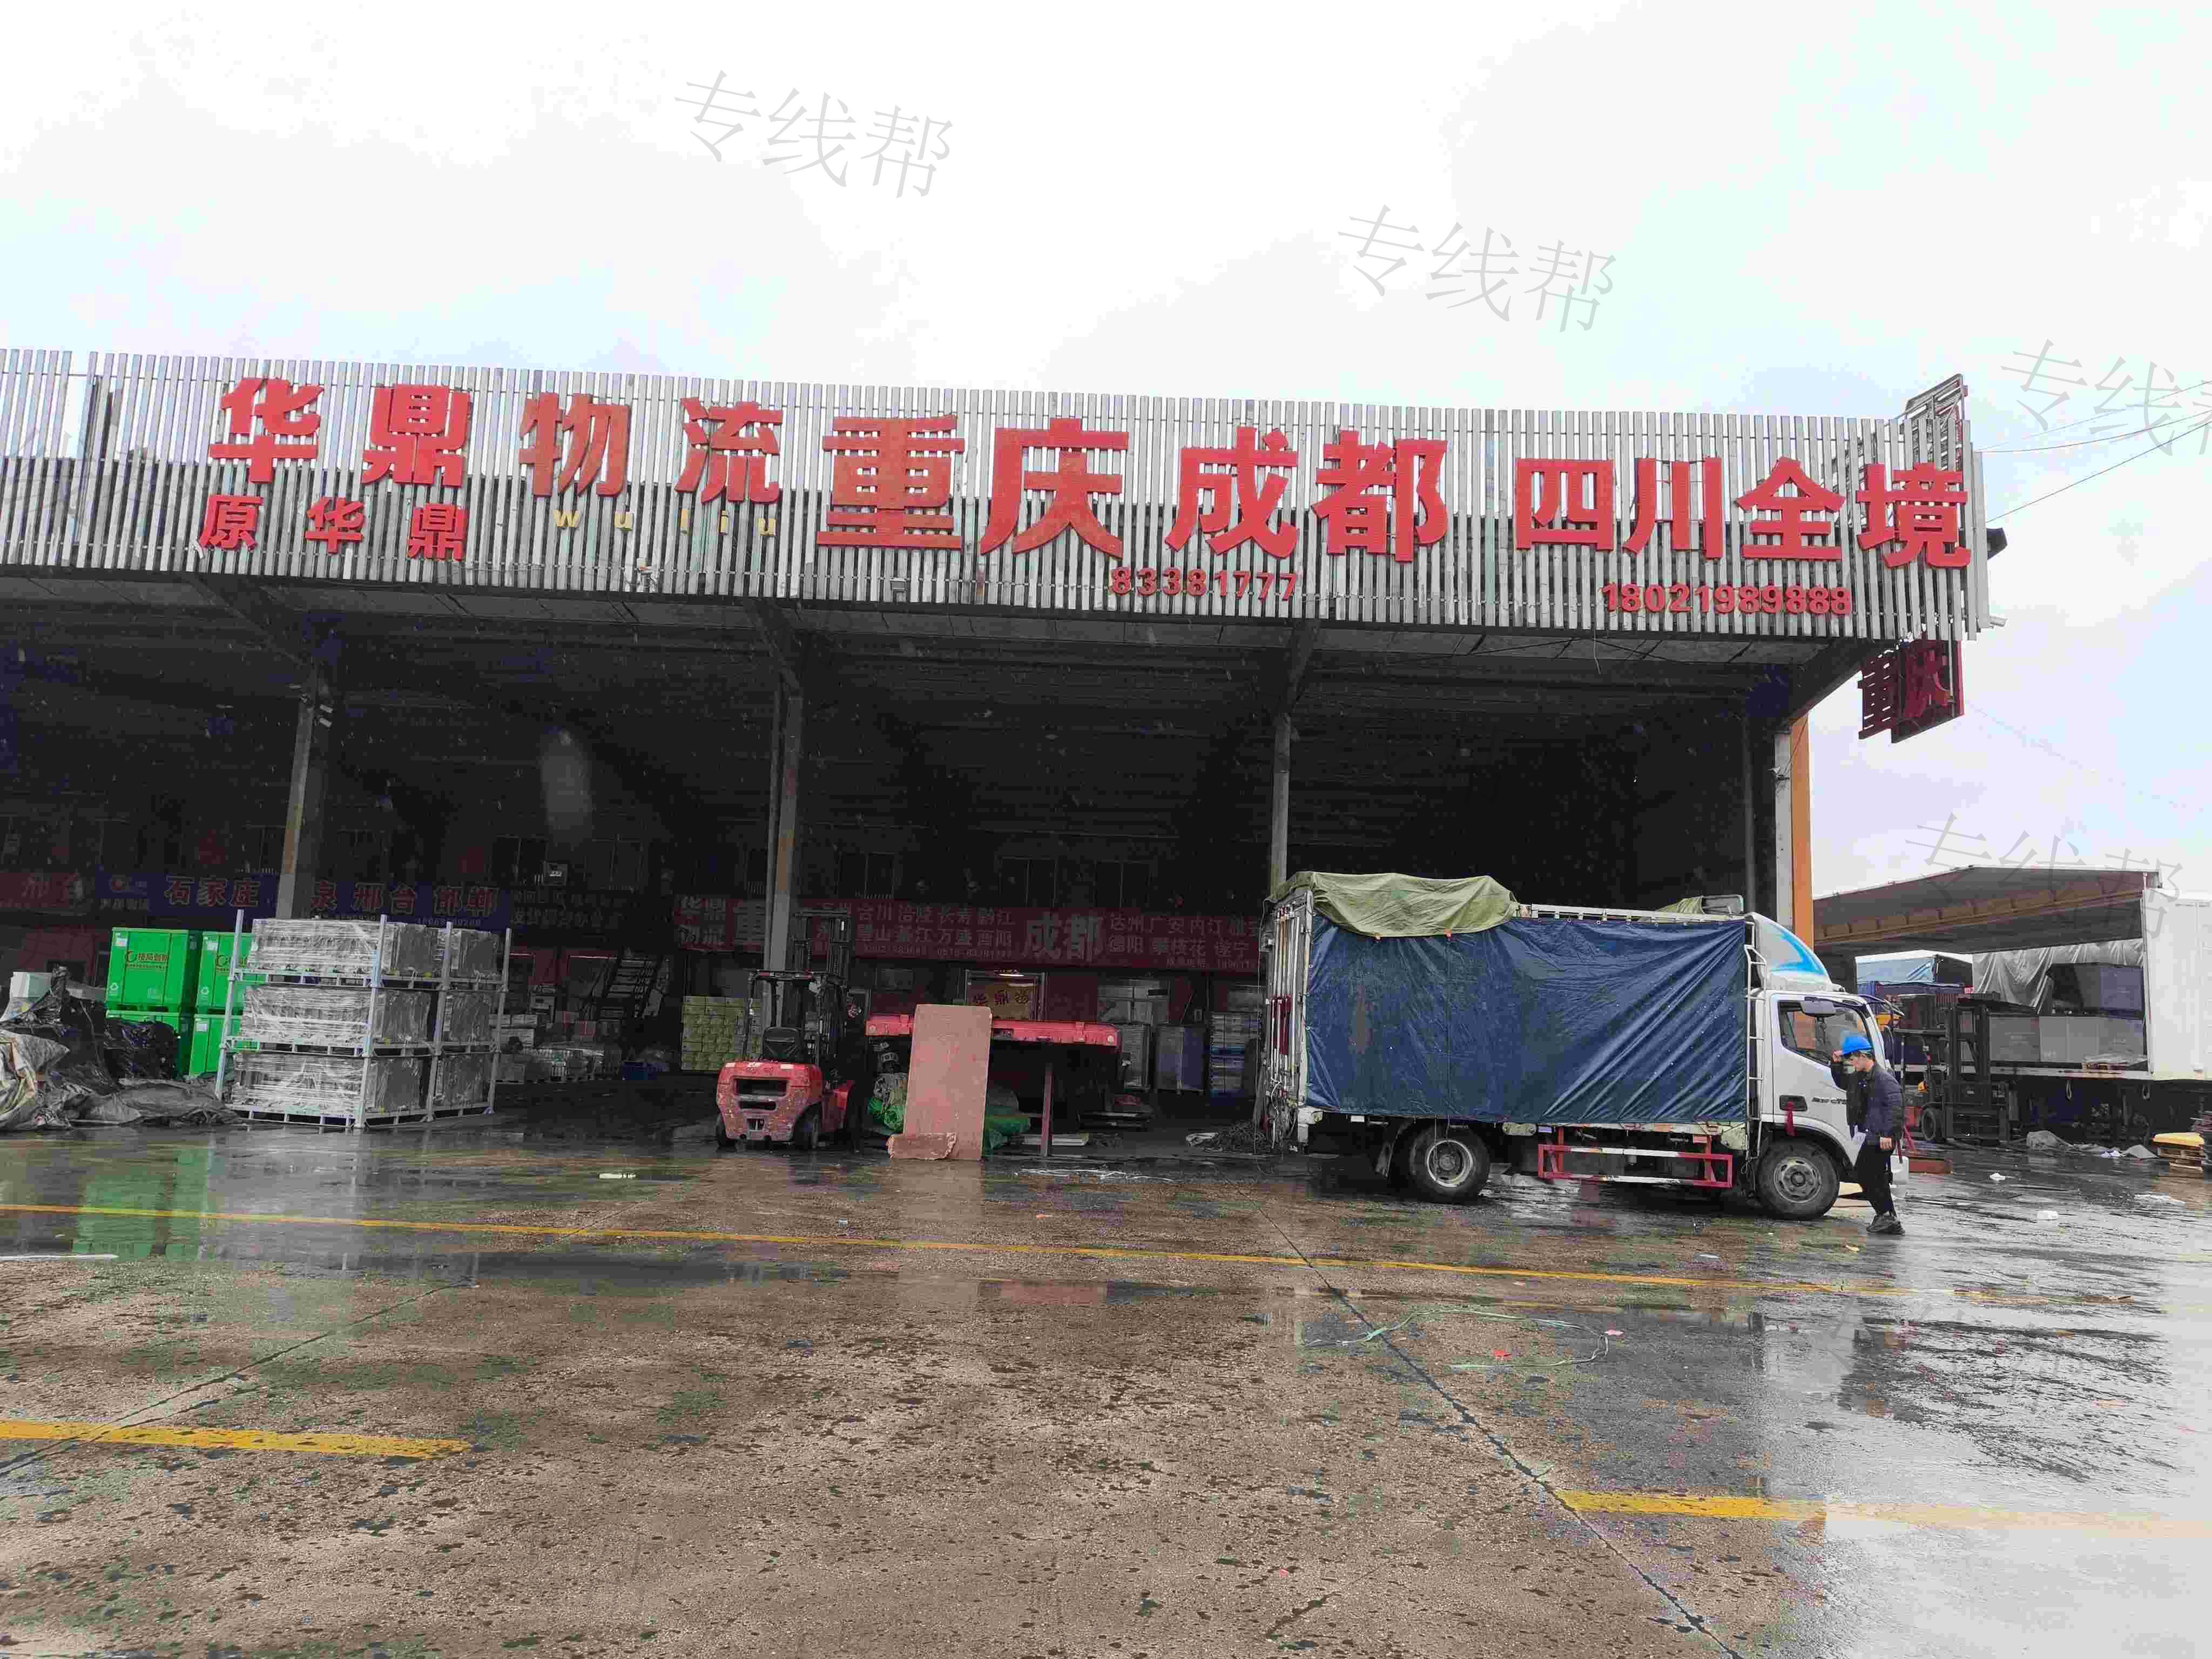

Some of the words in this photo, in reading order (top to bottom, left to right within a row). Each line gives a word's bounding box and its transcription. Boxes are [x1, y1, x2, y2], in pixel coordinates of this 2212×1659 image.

[210, 377, 783, 503] 华鼎物流
[1516, 456, 1971, 569] 四川全境
[199, 494, 468, 561] 原华鼎
[1110, 567, 1298, 601] 83381777
[1602, 582, 1851, 615] 18021989888
